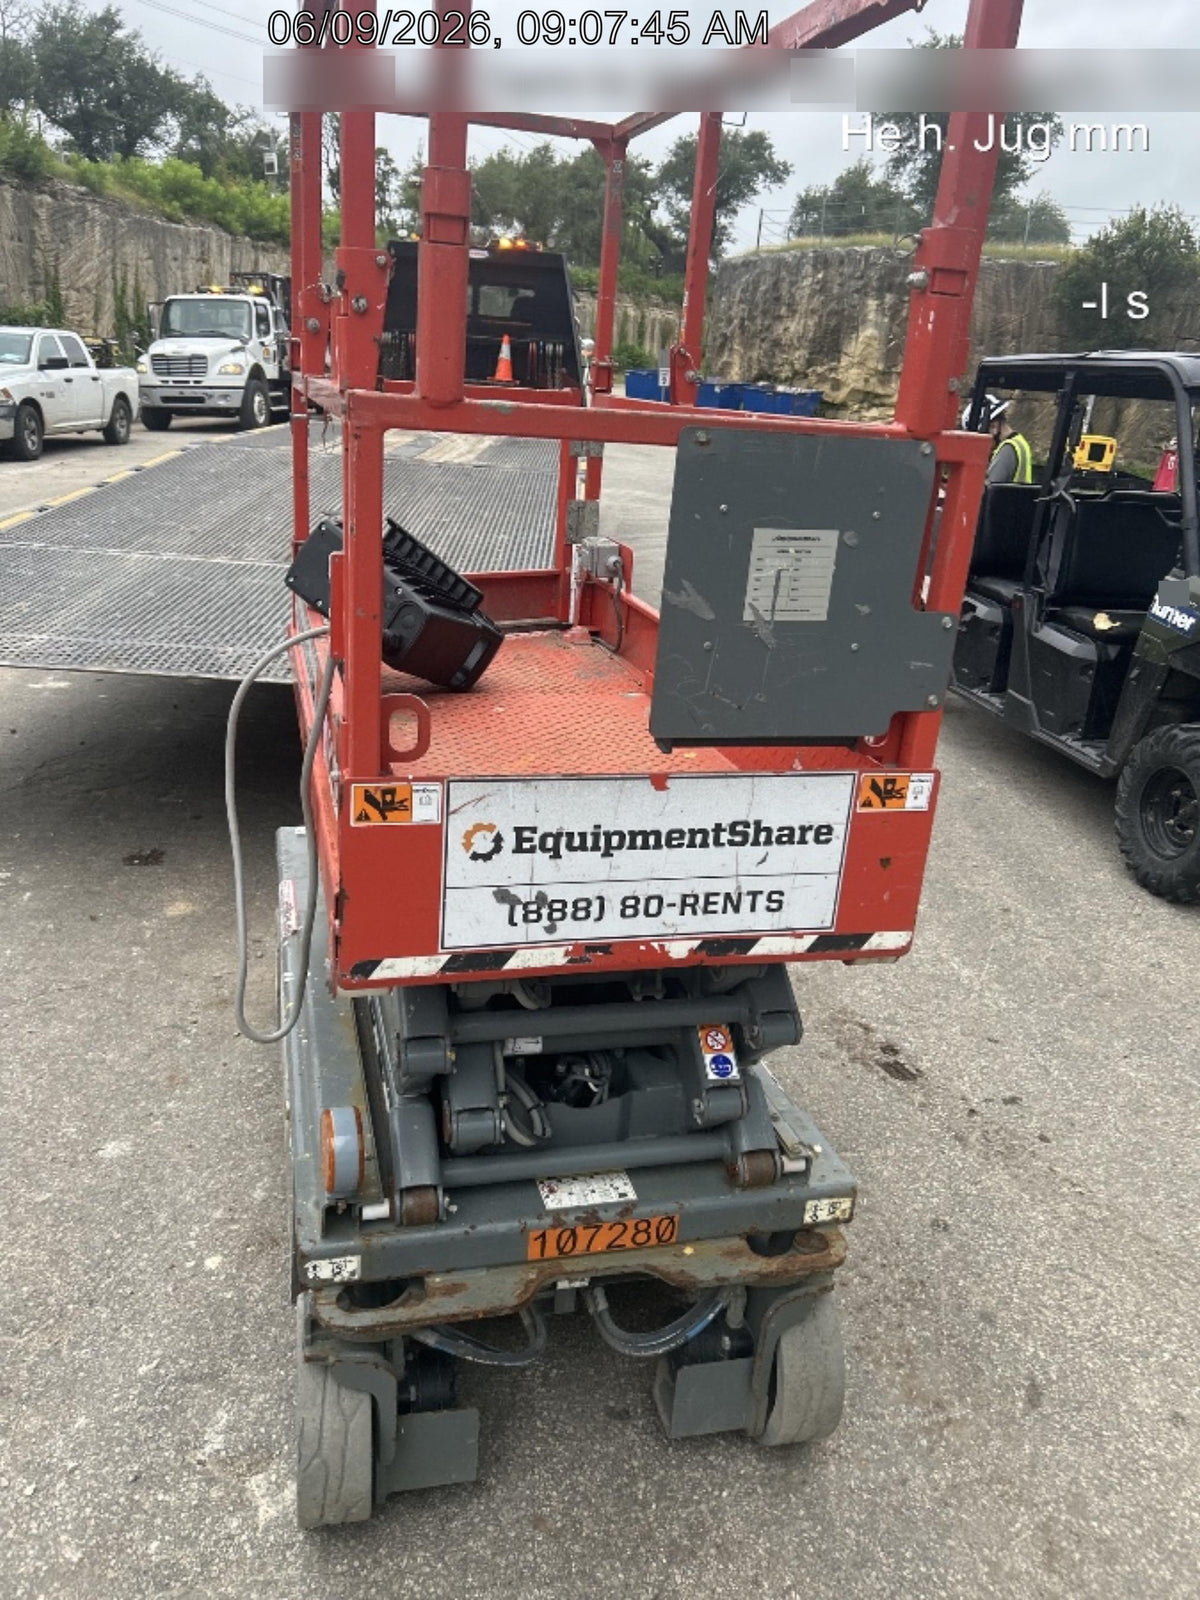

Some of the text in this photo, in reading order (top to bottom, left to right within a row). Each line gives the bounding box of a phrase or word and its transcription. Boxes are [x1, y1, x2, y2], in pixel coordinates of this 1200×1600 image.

[512, 820, 834, 859] EquipmentShare
[507, 890, 785, 926] (888) 80-RENTS
[533, 1215, 676, 1258] 107280
